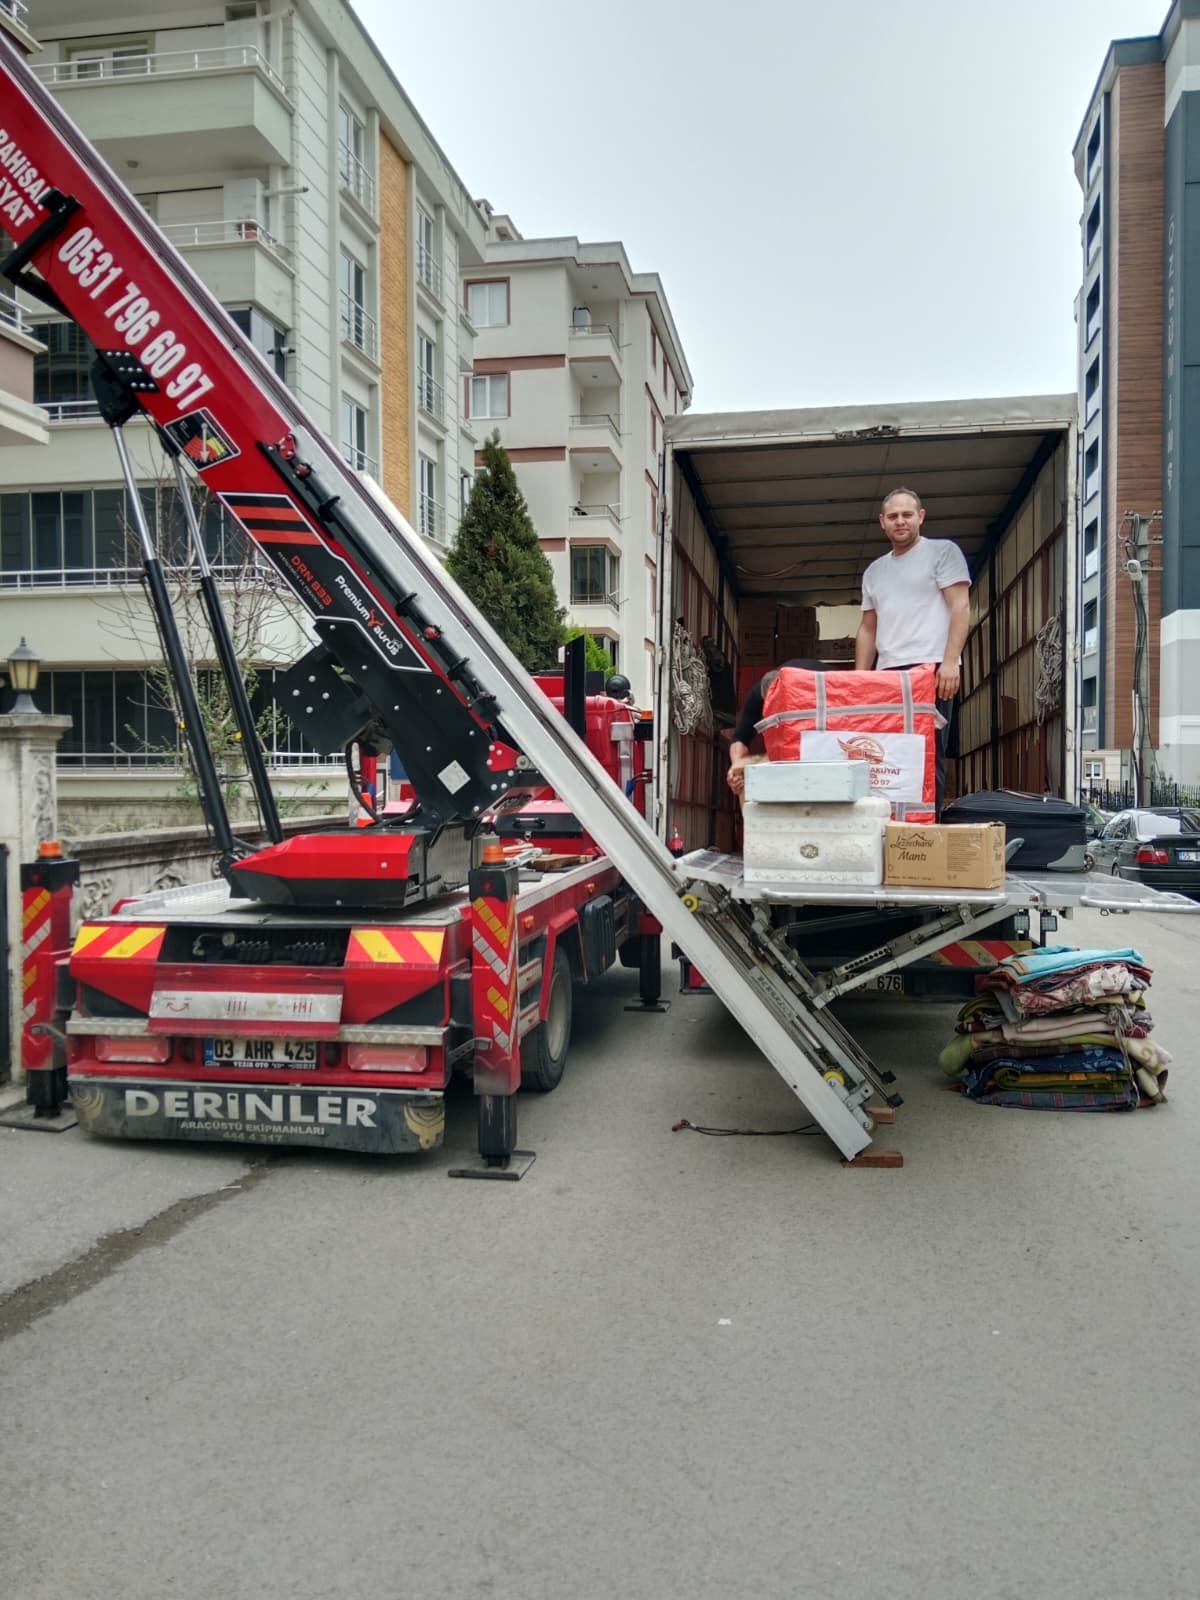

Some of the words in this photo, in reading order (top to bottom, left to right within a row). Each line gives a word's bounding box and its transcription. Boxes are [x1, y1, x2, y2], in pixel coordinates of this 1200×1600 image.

[58, 226, 123, 299] 0531
[104, 281, 160, 345] 796
[140, 330, 186, 378] 60
[166, 362, 214, 411] 97
[291, 555, 314, 582] DRN
[334, 574, 371, 621] Premium
[877, 975, 901, 990] 676
[214, 1040, 234, 1059] 03
[244, 1040, 274, 1060] AHR
[284, 1041, 315, 1061] 425
[180, 1120, 243, 1131] ARAÇÜSTÜ
